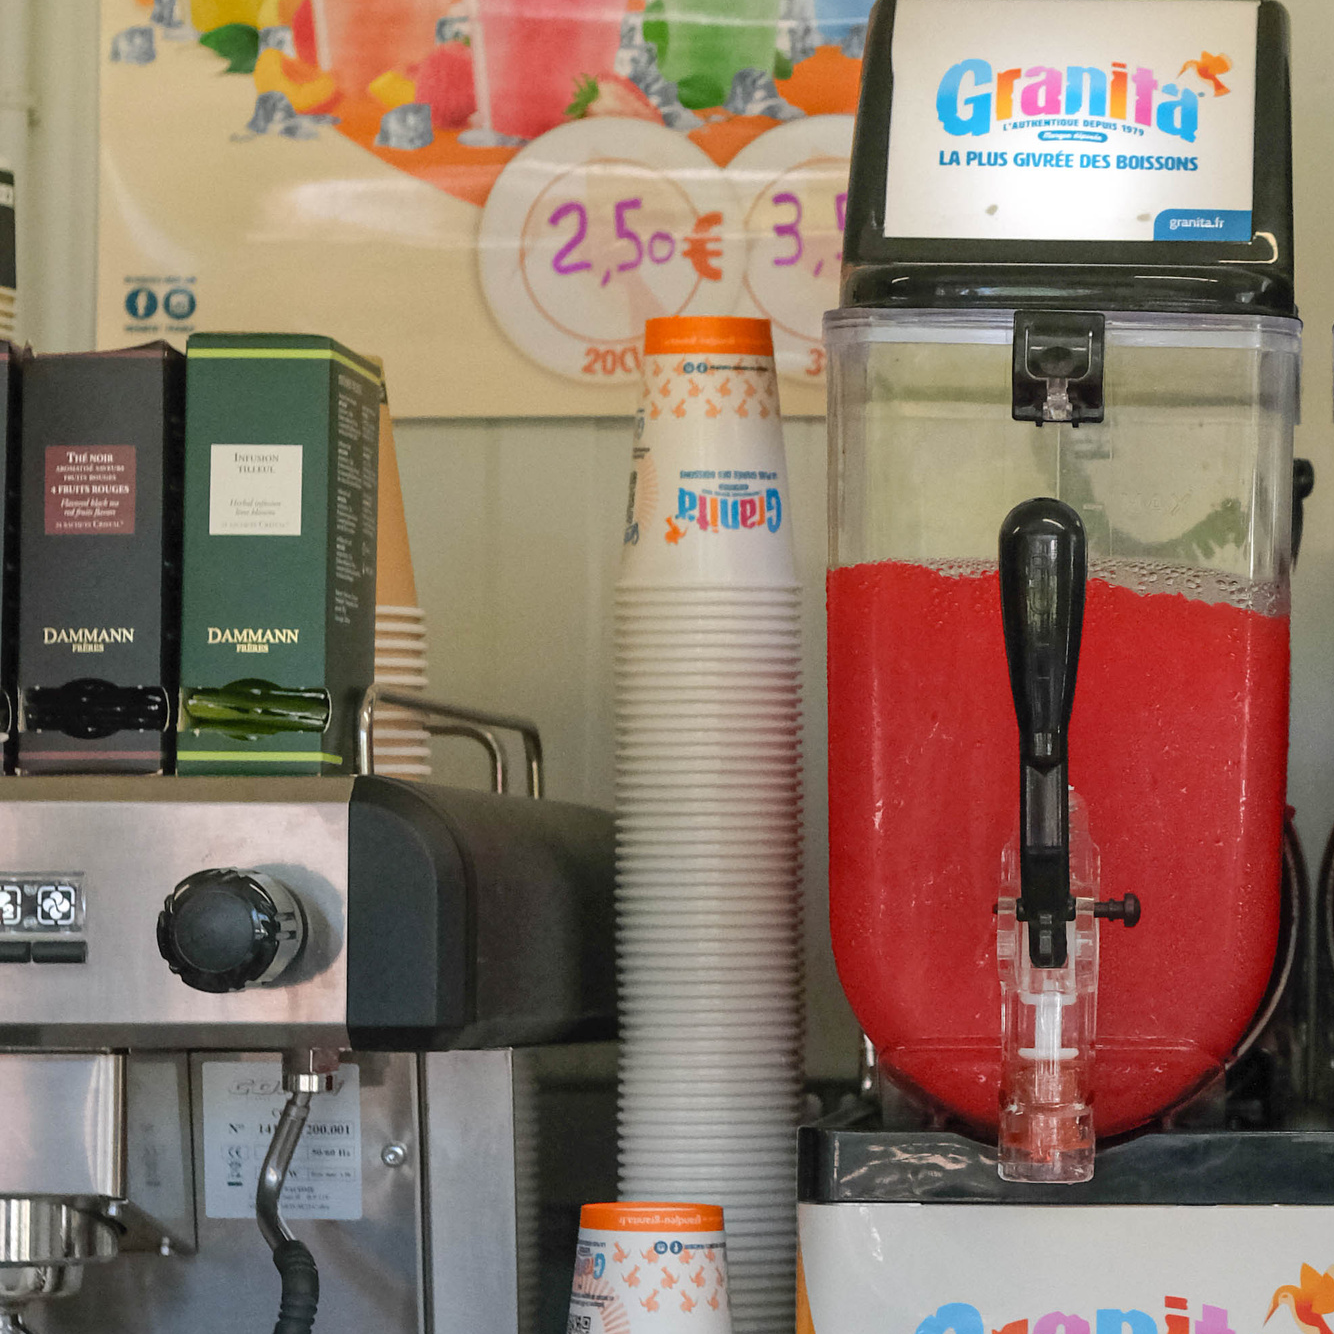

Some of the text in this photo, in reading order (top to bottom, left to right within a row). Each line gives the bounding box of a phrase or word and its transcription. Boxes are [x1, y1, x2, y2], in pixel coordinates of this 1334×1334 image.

[936, 59, 1199, 143] Granita
[1003, 119, 1144, 136] L'AUTHENTIQUE DEPUIS 1979
[939, 150, 1199, 172] LA PLUS GIVRÉE DES BOISSONS
[1169, 216, 1224, 230] granita.fr
[678, 487, 782, 534] Granita
[43, 627, 134, 644] DAMMANN
[207, 627, 299, 644] DAMMANN
